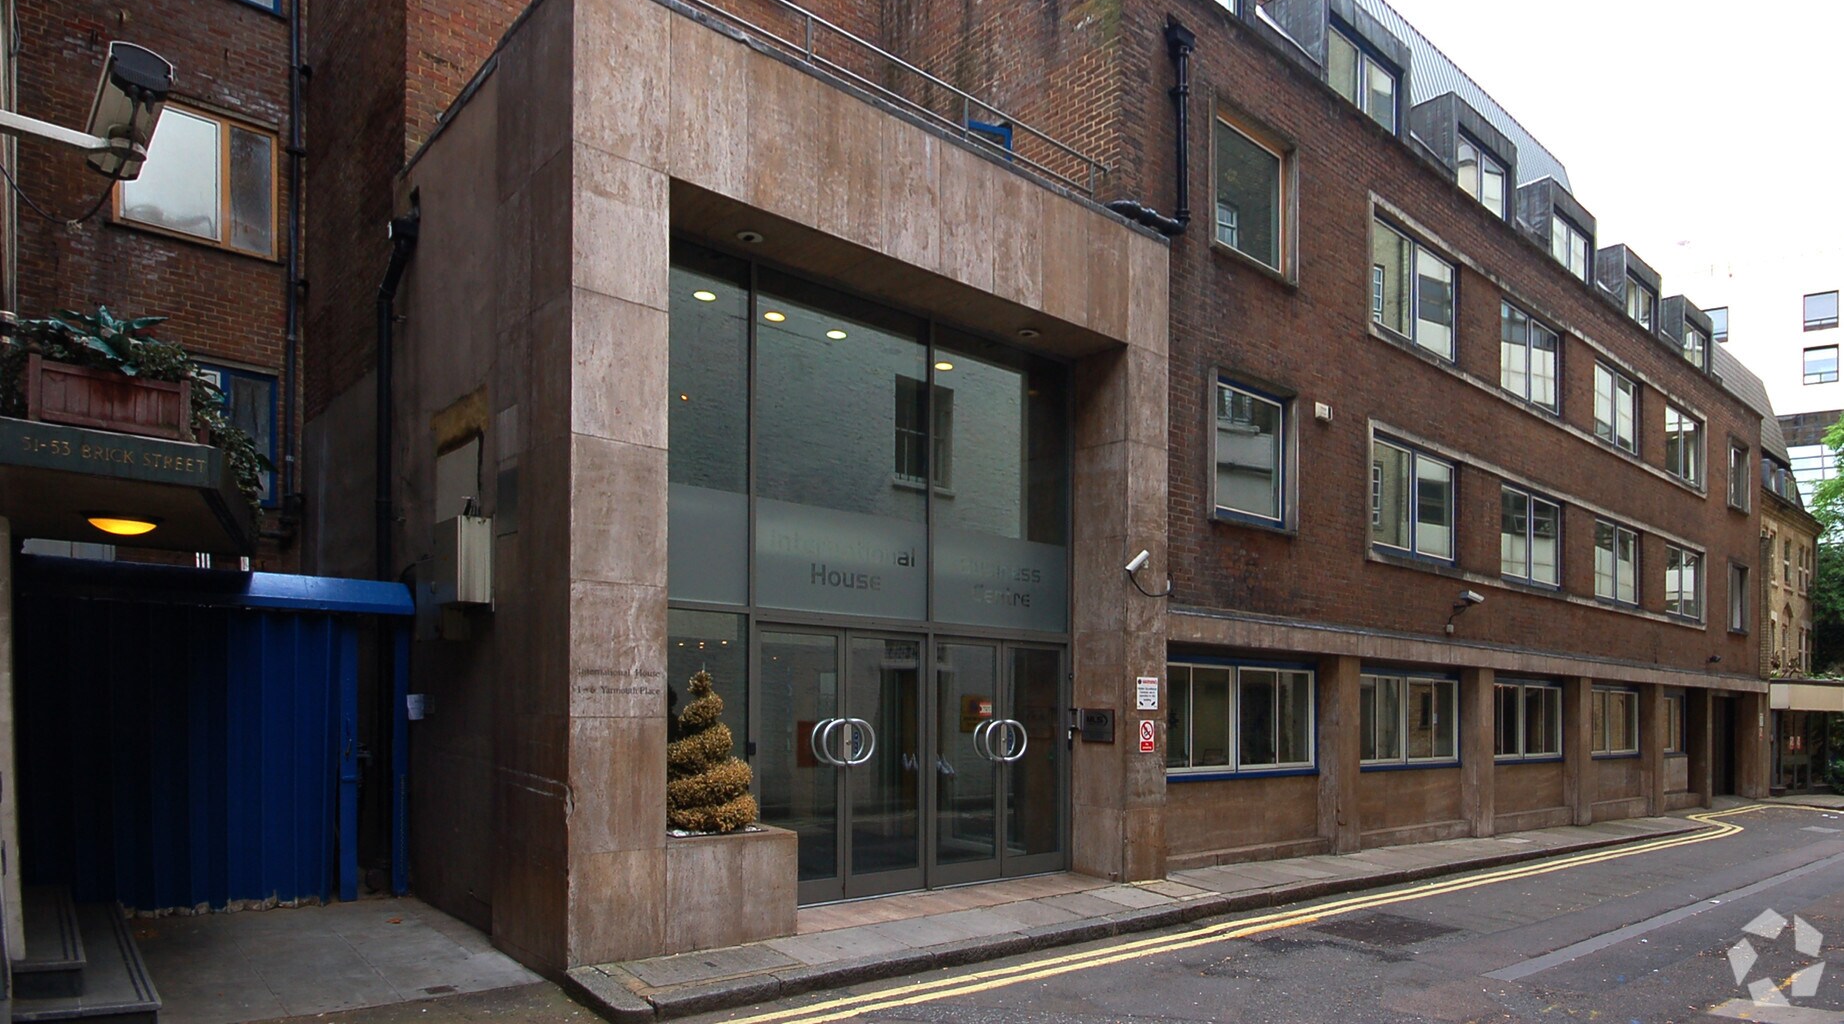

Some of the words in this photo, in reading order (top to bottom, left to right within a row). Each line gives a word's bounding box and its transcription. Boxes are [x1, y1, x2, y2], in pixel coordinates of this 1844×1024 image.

[21, 436, 72, 456] 51-53
[81, 444, 135, 464] BRICK
[143, 452, 208, 473] STREET
[810, 562, 881, 592] House
[635, 668, 660, 677] House
[639, 686, 660, 695] Place
